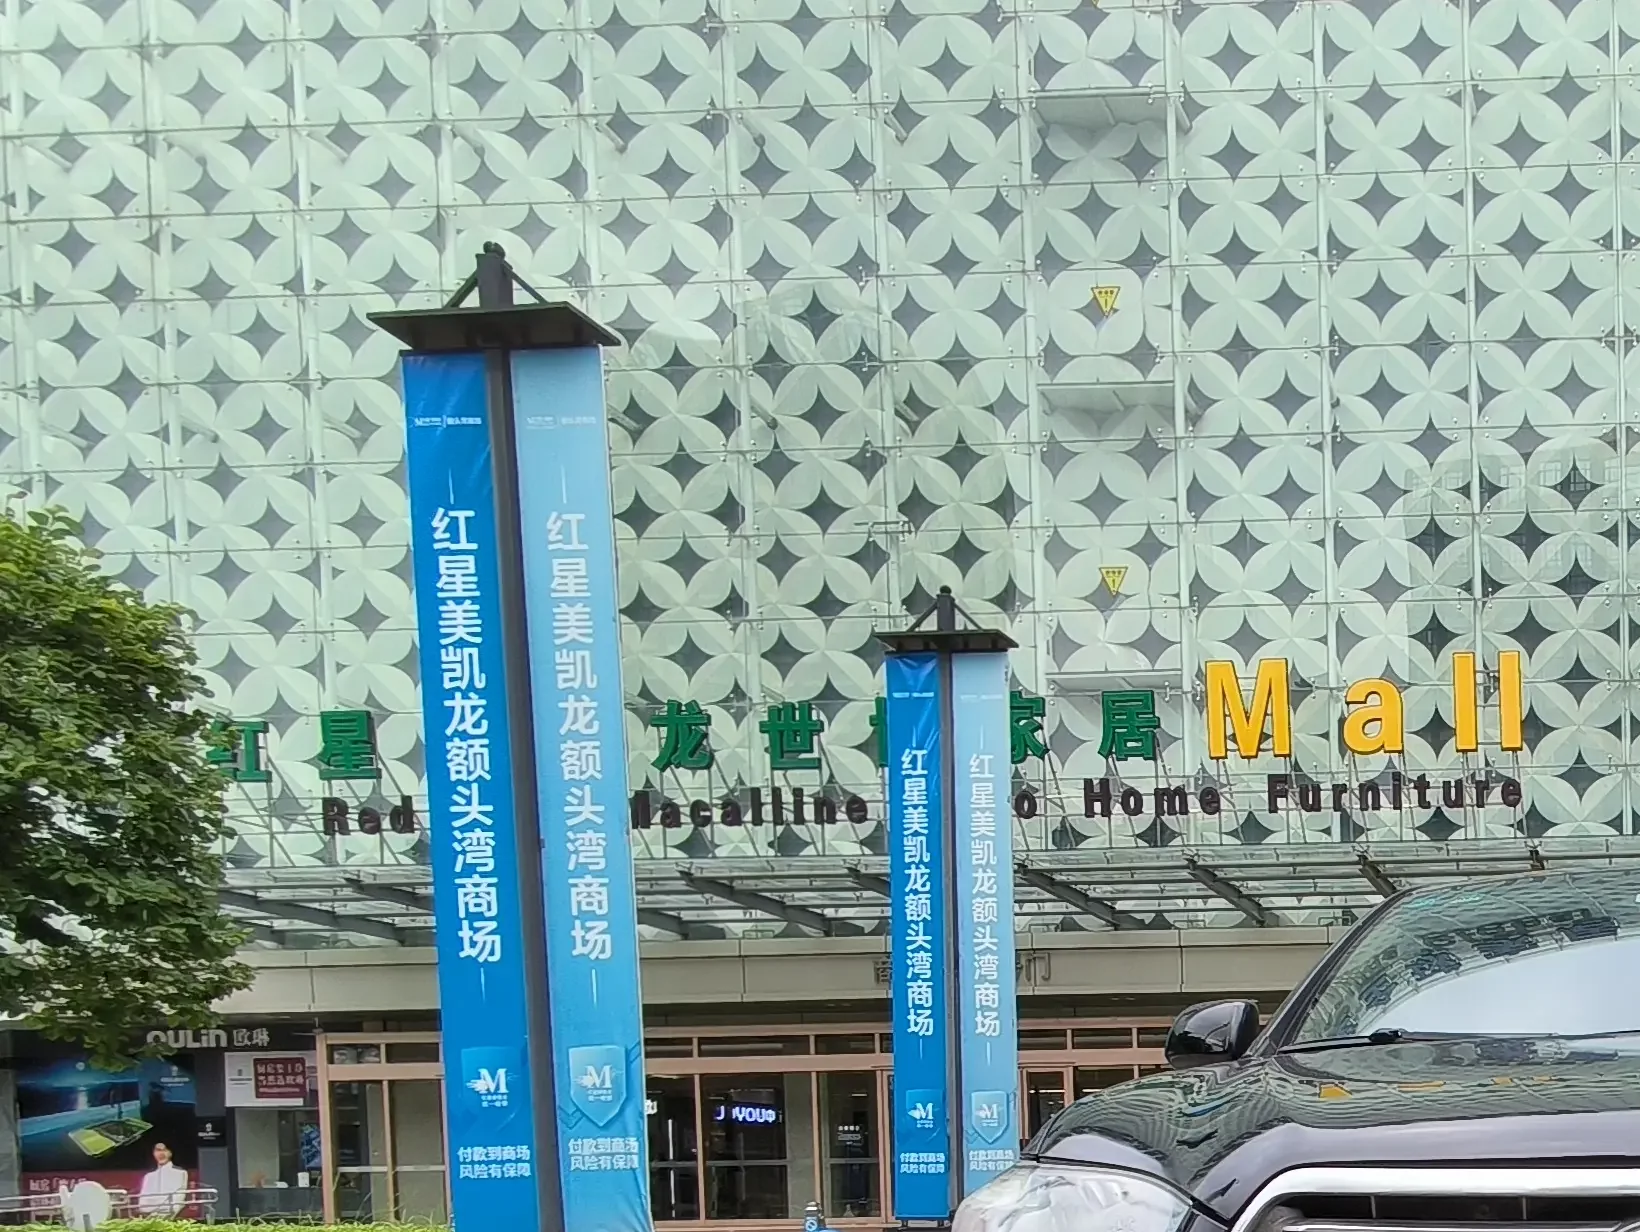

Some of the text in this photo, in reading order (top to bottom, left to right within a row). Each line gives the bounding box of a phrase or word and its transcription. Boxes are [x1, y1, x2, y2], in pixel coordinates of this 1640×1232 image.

[431, 507, 502, 964] 红星美凯龙额头湾商场
[546, 511, 612, 962] 红星美凯龙额头湾商场
[1204, 650, 1524, 760] Mall
[322, 795, 415, 836] Red
[1083, 776, 1222, 819] Home
[1267, 772, 1523, 814] Furniture
[900, 749, 934, 1037] 红星美凯龙额头湾商场
[968, 753, 1000, 1038] 红星美凯龙额头湾商场
[457, 1145, 531, 1162] 付款到商场
[459, 1162, 532, 1180] 风险有保障
[568, 1137, 639, 1155] 付款到商场
